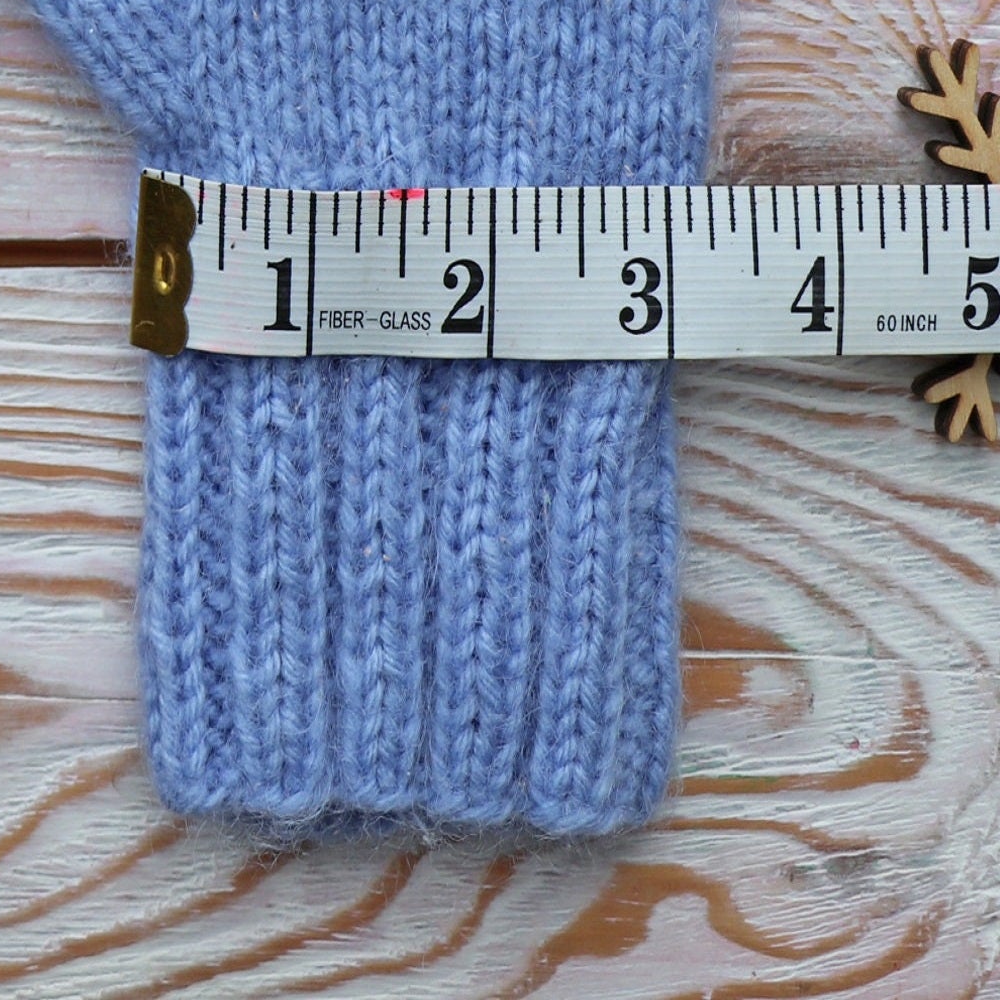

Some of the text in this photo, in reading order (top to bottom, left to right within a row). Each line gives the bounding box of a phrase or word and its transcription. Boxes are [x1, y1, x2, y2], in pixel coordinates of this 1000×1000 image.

[263, 257, 302, 332] 1
[440, 258, 485, 334] 2
[618, 256, 663, 336] 3
[790, 255, 835, 333] 4
[962, 256, 1000, 331] 5
